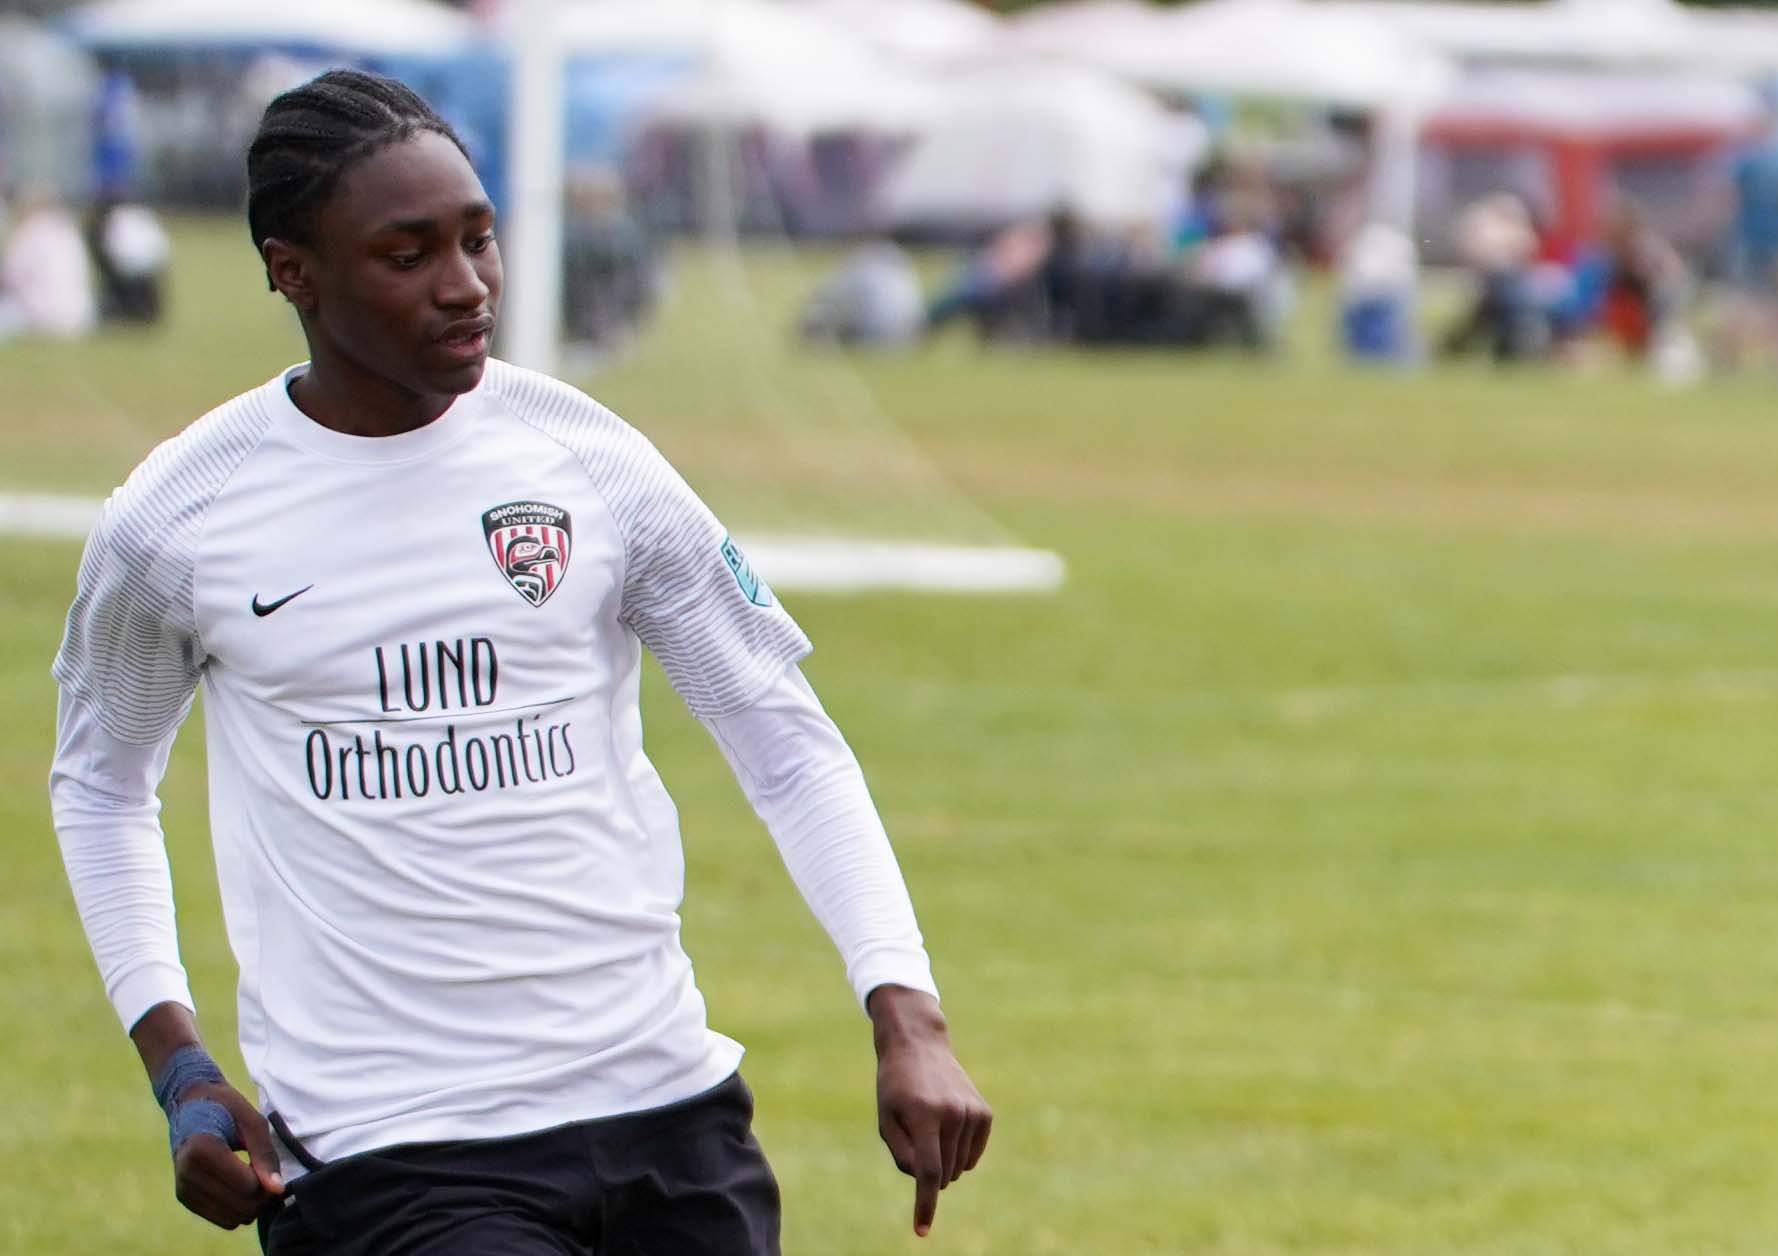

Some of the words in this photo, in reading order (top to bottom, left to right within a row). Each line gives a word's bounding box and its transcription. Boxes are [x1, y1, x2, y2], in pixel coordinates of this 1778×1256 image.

[489, 504, 564, 520] SNOHOMISH
[502, 515, 555, 525] UNITED
[375, 637, 499, 713] LUND
[305, 714, 576, 801] Orthodontics
